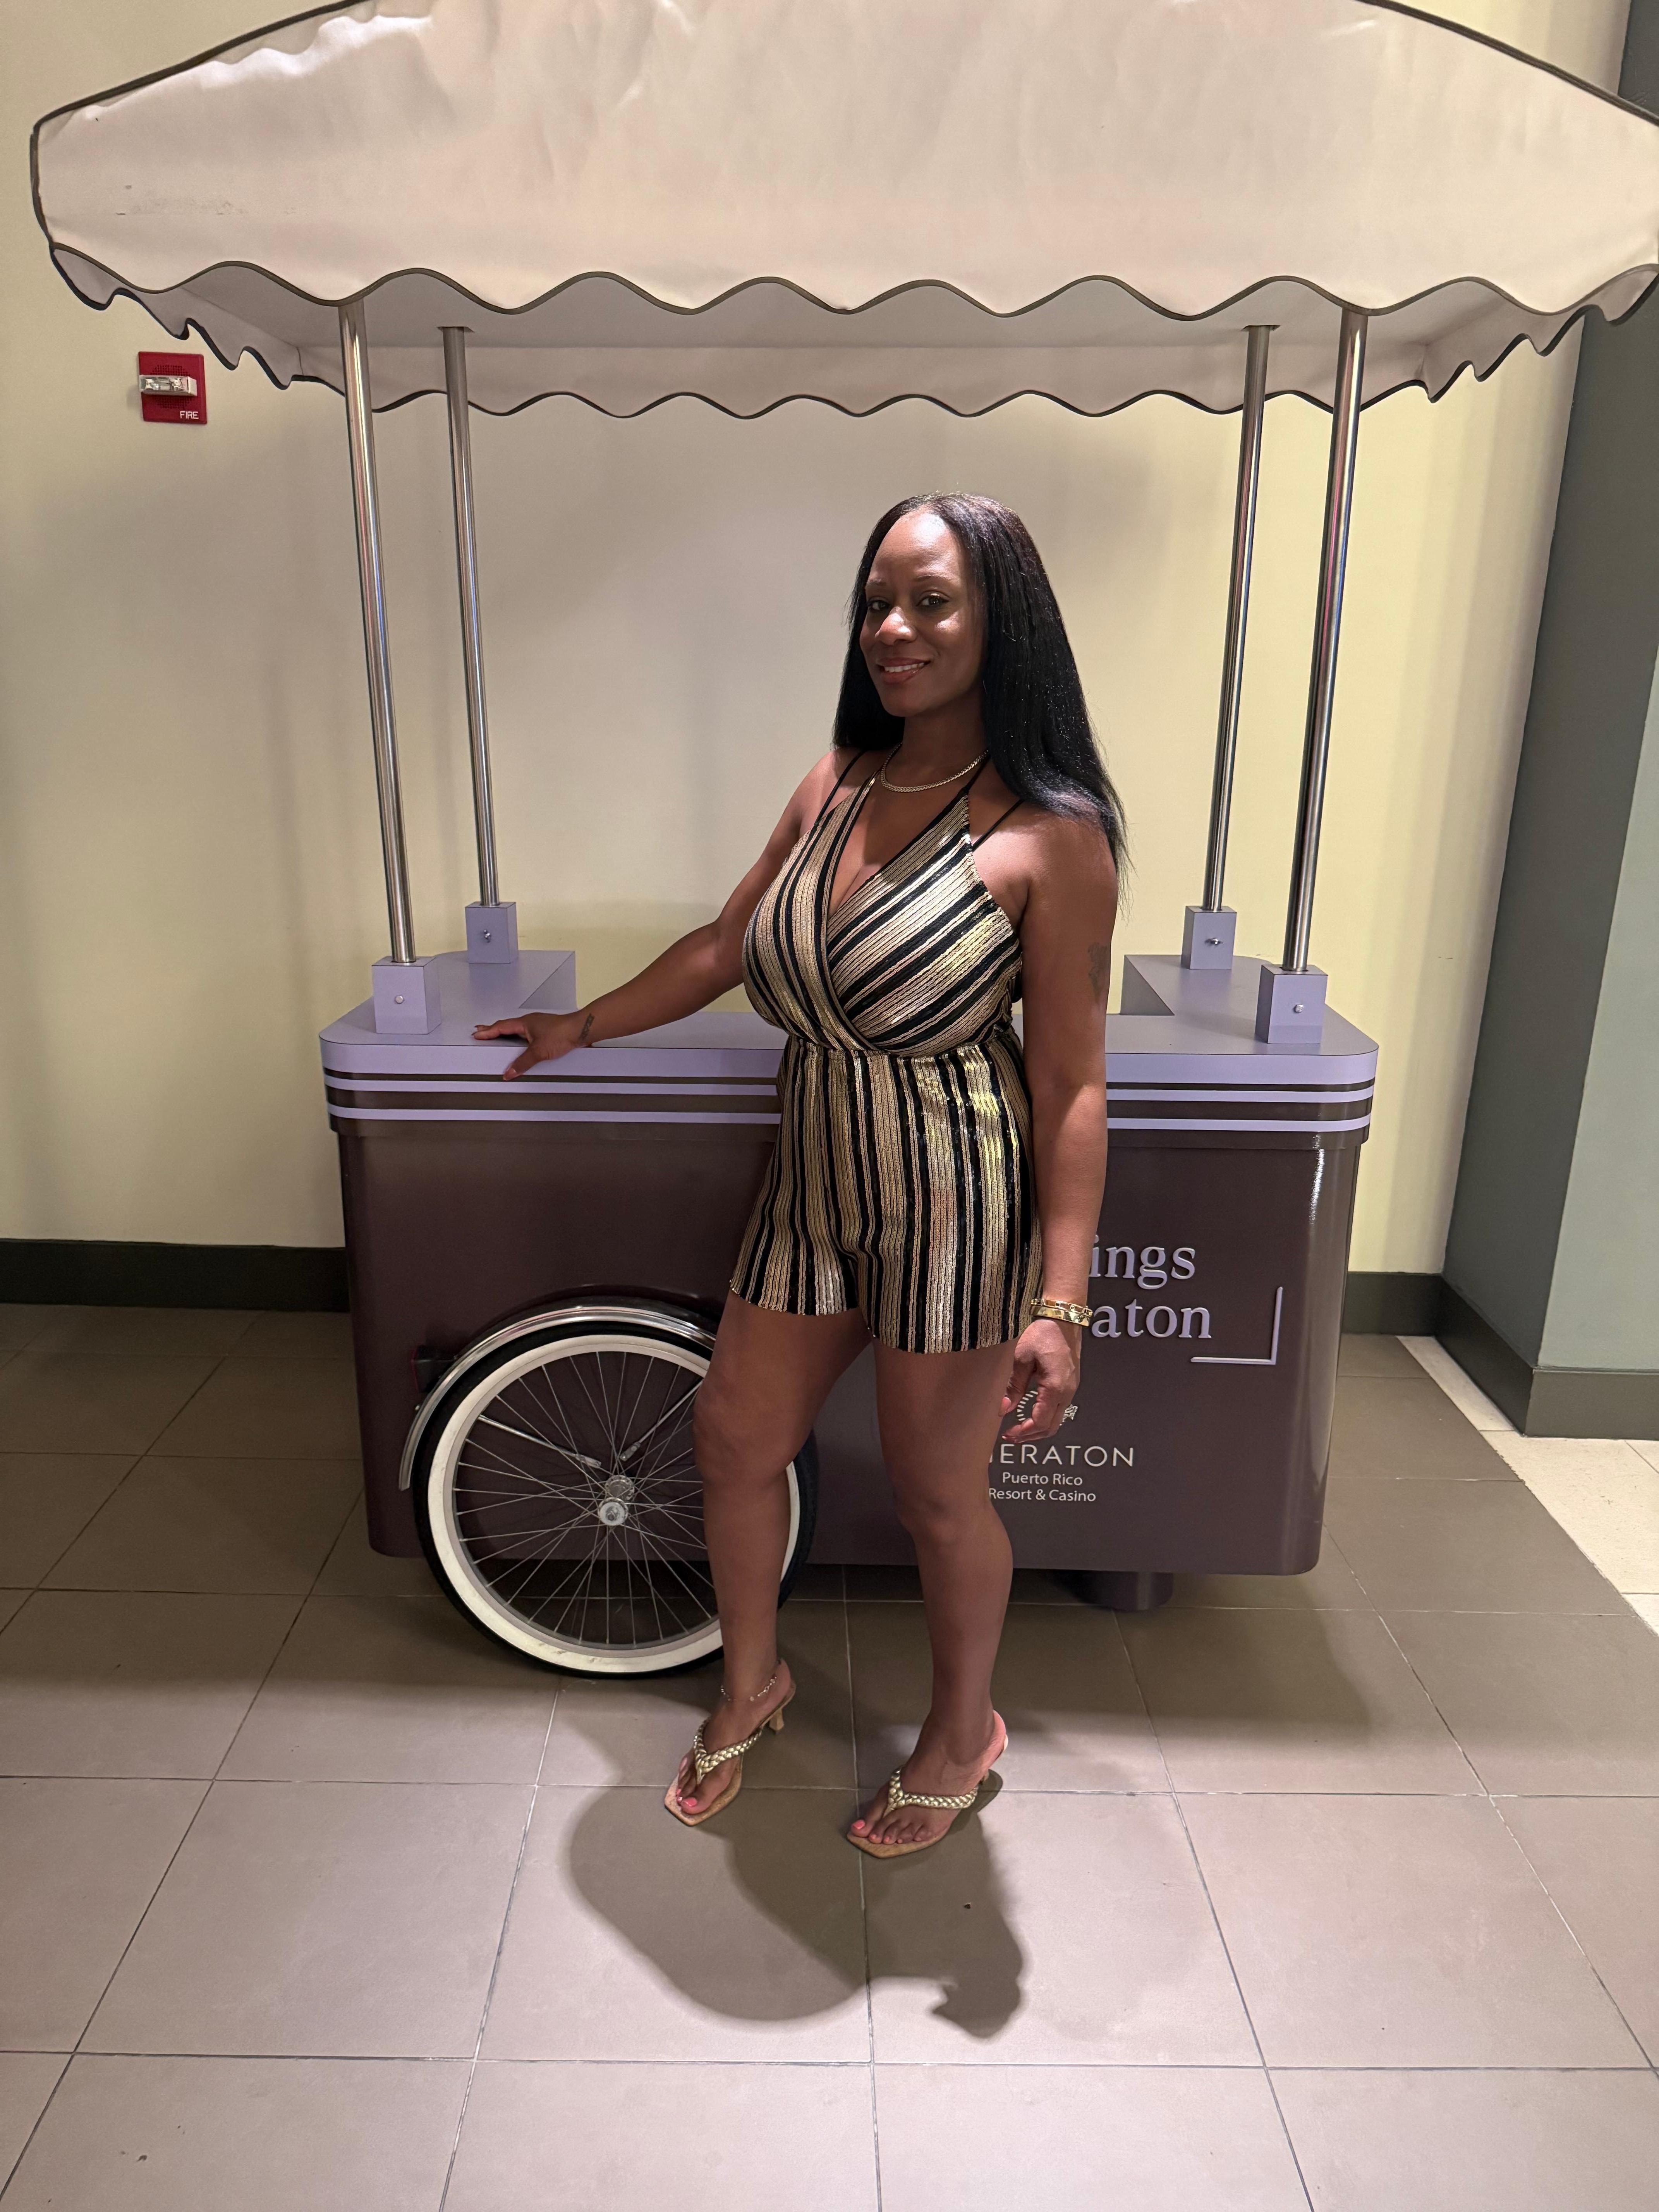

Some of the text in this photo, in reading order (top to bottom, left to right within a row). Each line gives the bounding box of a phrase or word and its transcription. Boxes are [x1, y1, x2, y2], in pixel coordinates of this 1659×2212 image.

[180, 411, 199, 419] FIRE
[989, 1444, 1133, 1467] ERATON
[1002, 1472, 1083, 1486] Puerto Rico
[989, 1488, 1096, 1502] Resort & Casino
